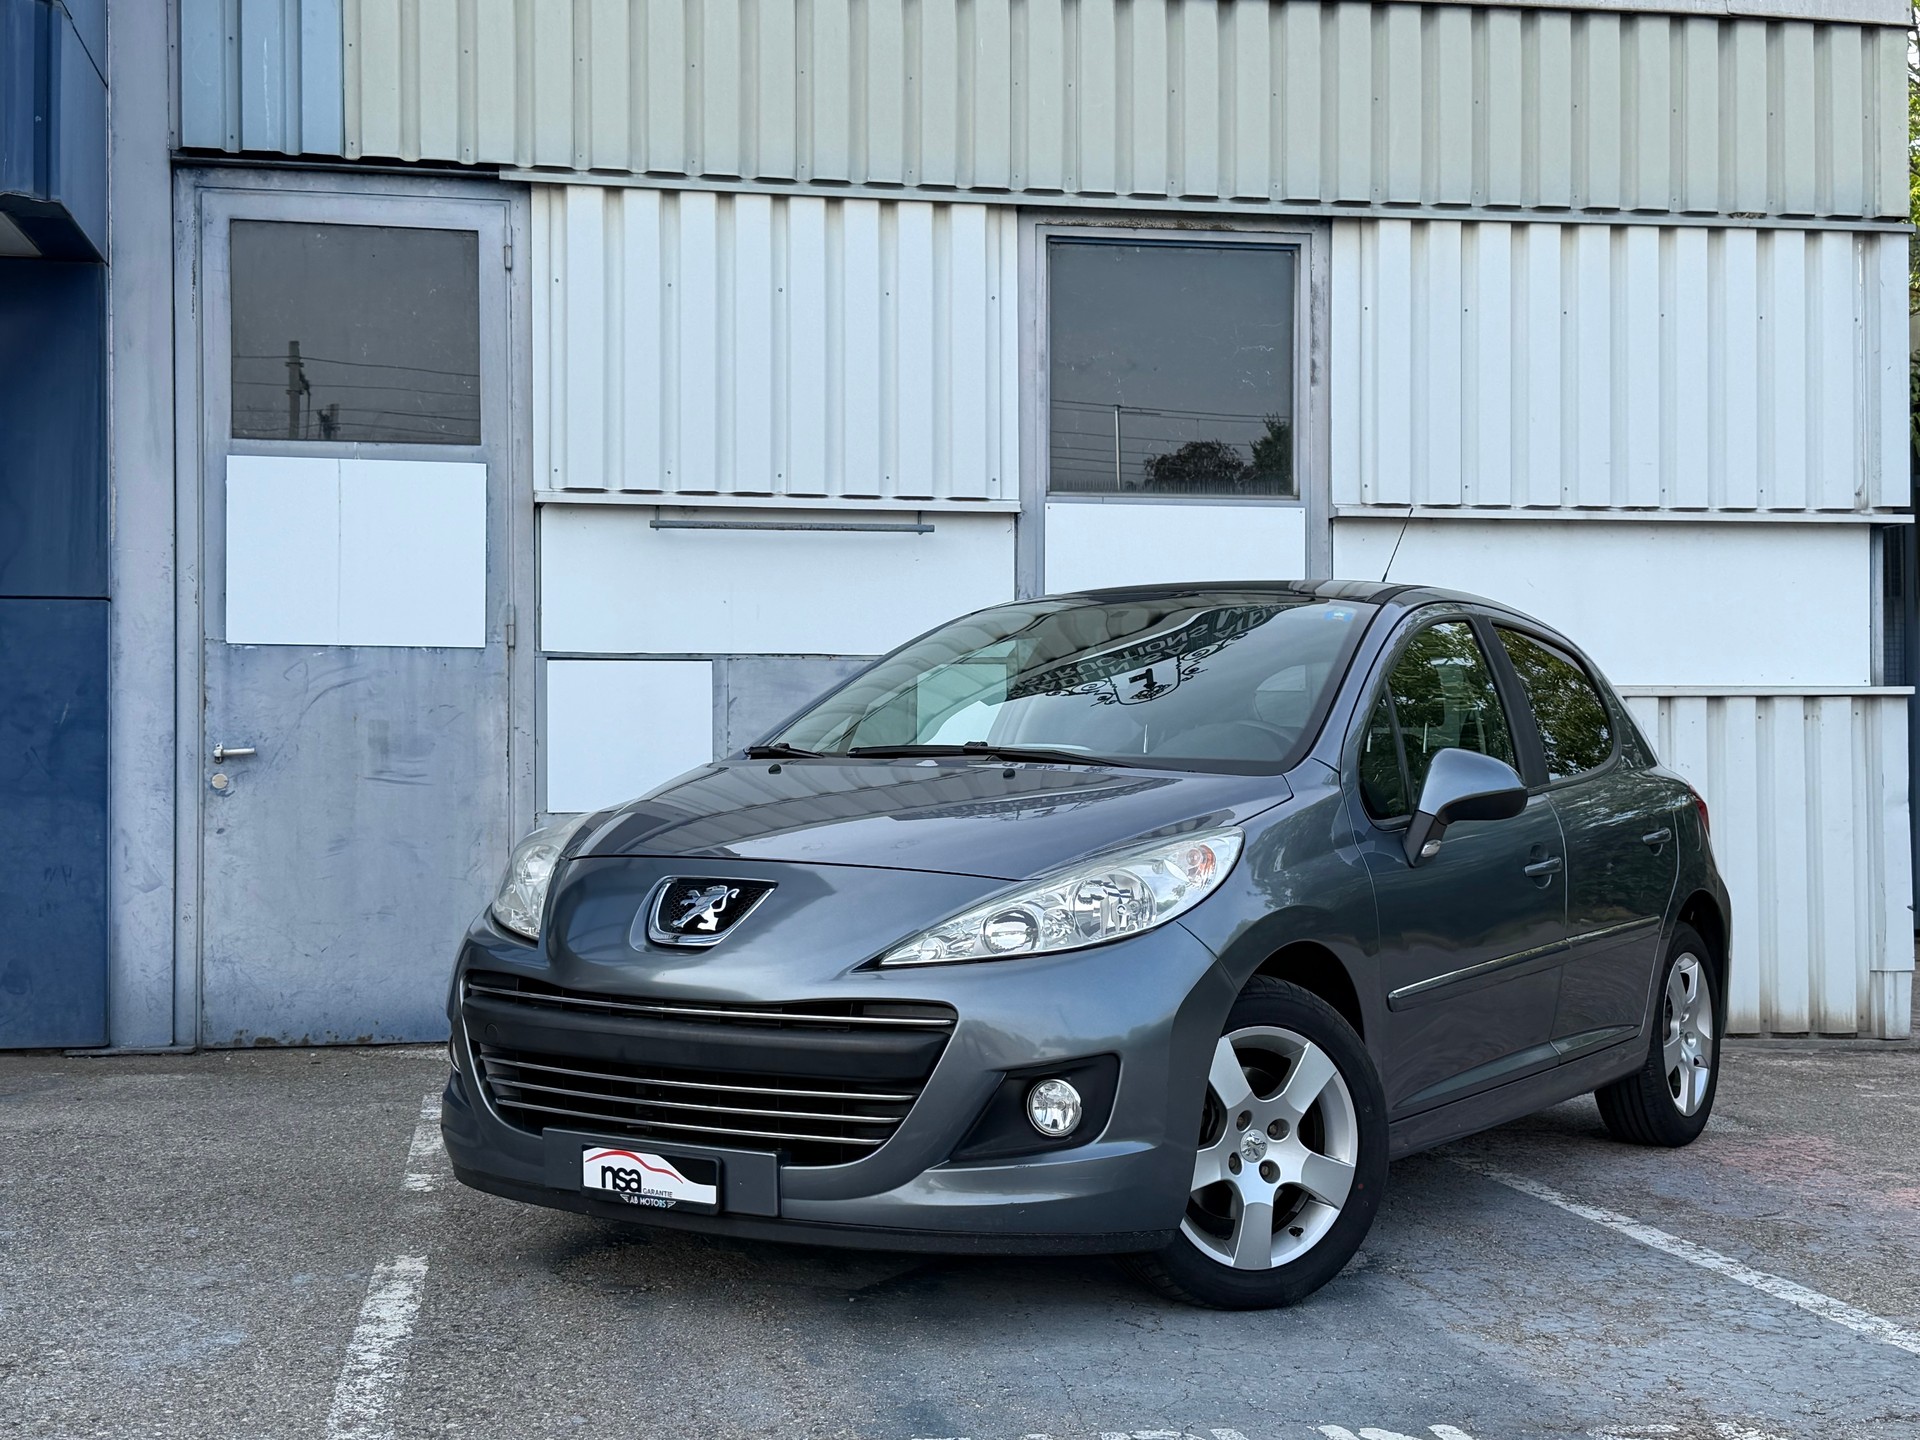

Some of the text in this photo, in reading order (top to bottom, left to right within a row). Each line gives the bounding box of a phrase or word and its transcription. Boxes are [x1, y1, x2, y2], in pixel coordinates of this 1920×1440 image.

[601, 1165, 641, 1192] nsa
[643, 1188, 673, 1197] GARANTIE
[640, 1197, 667, 1207] MOTORS
